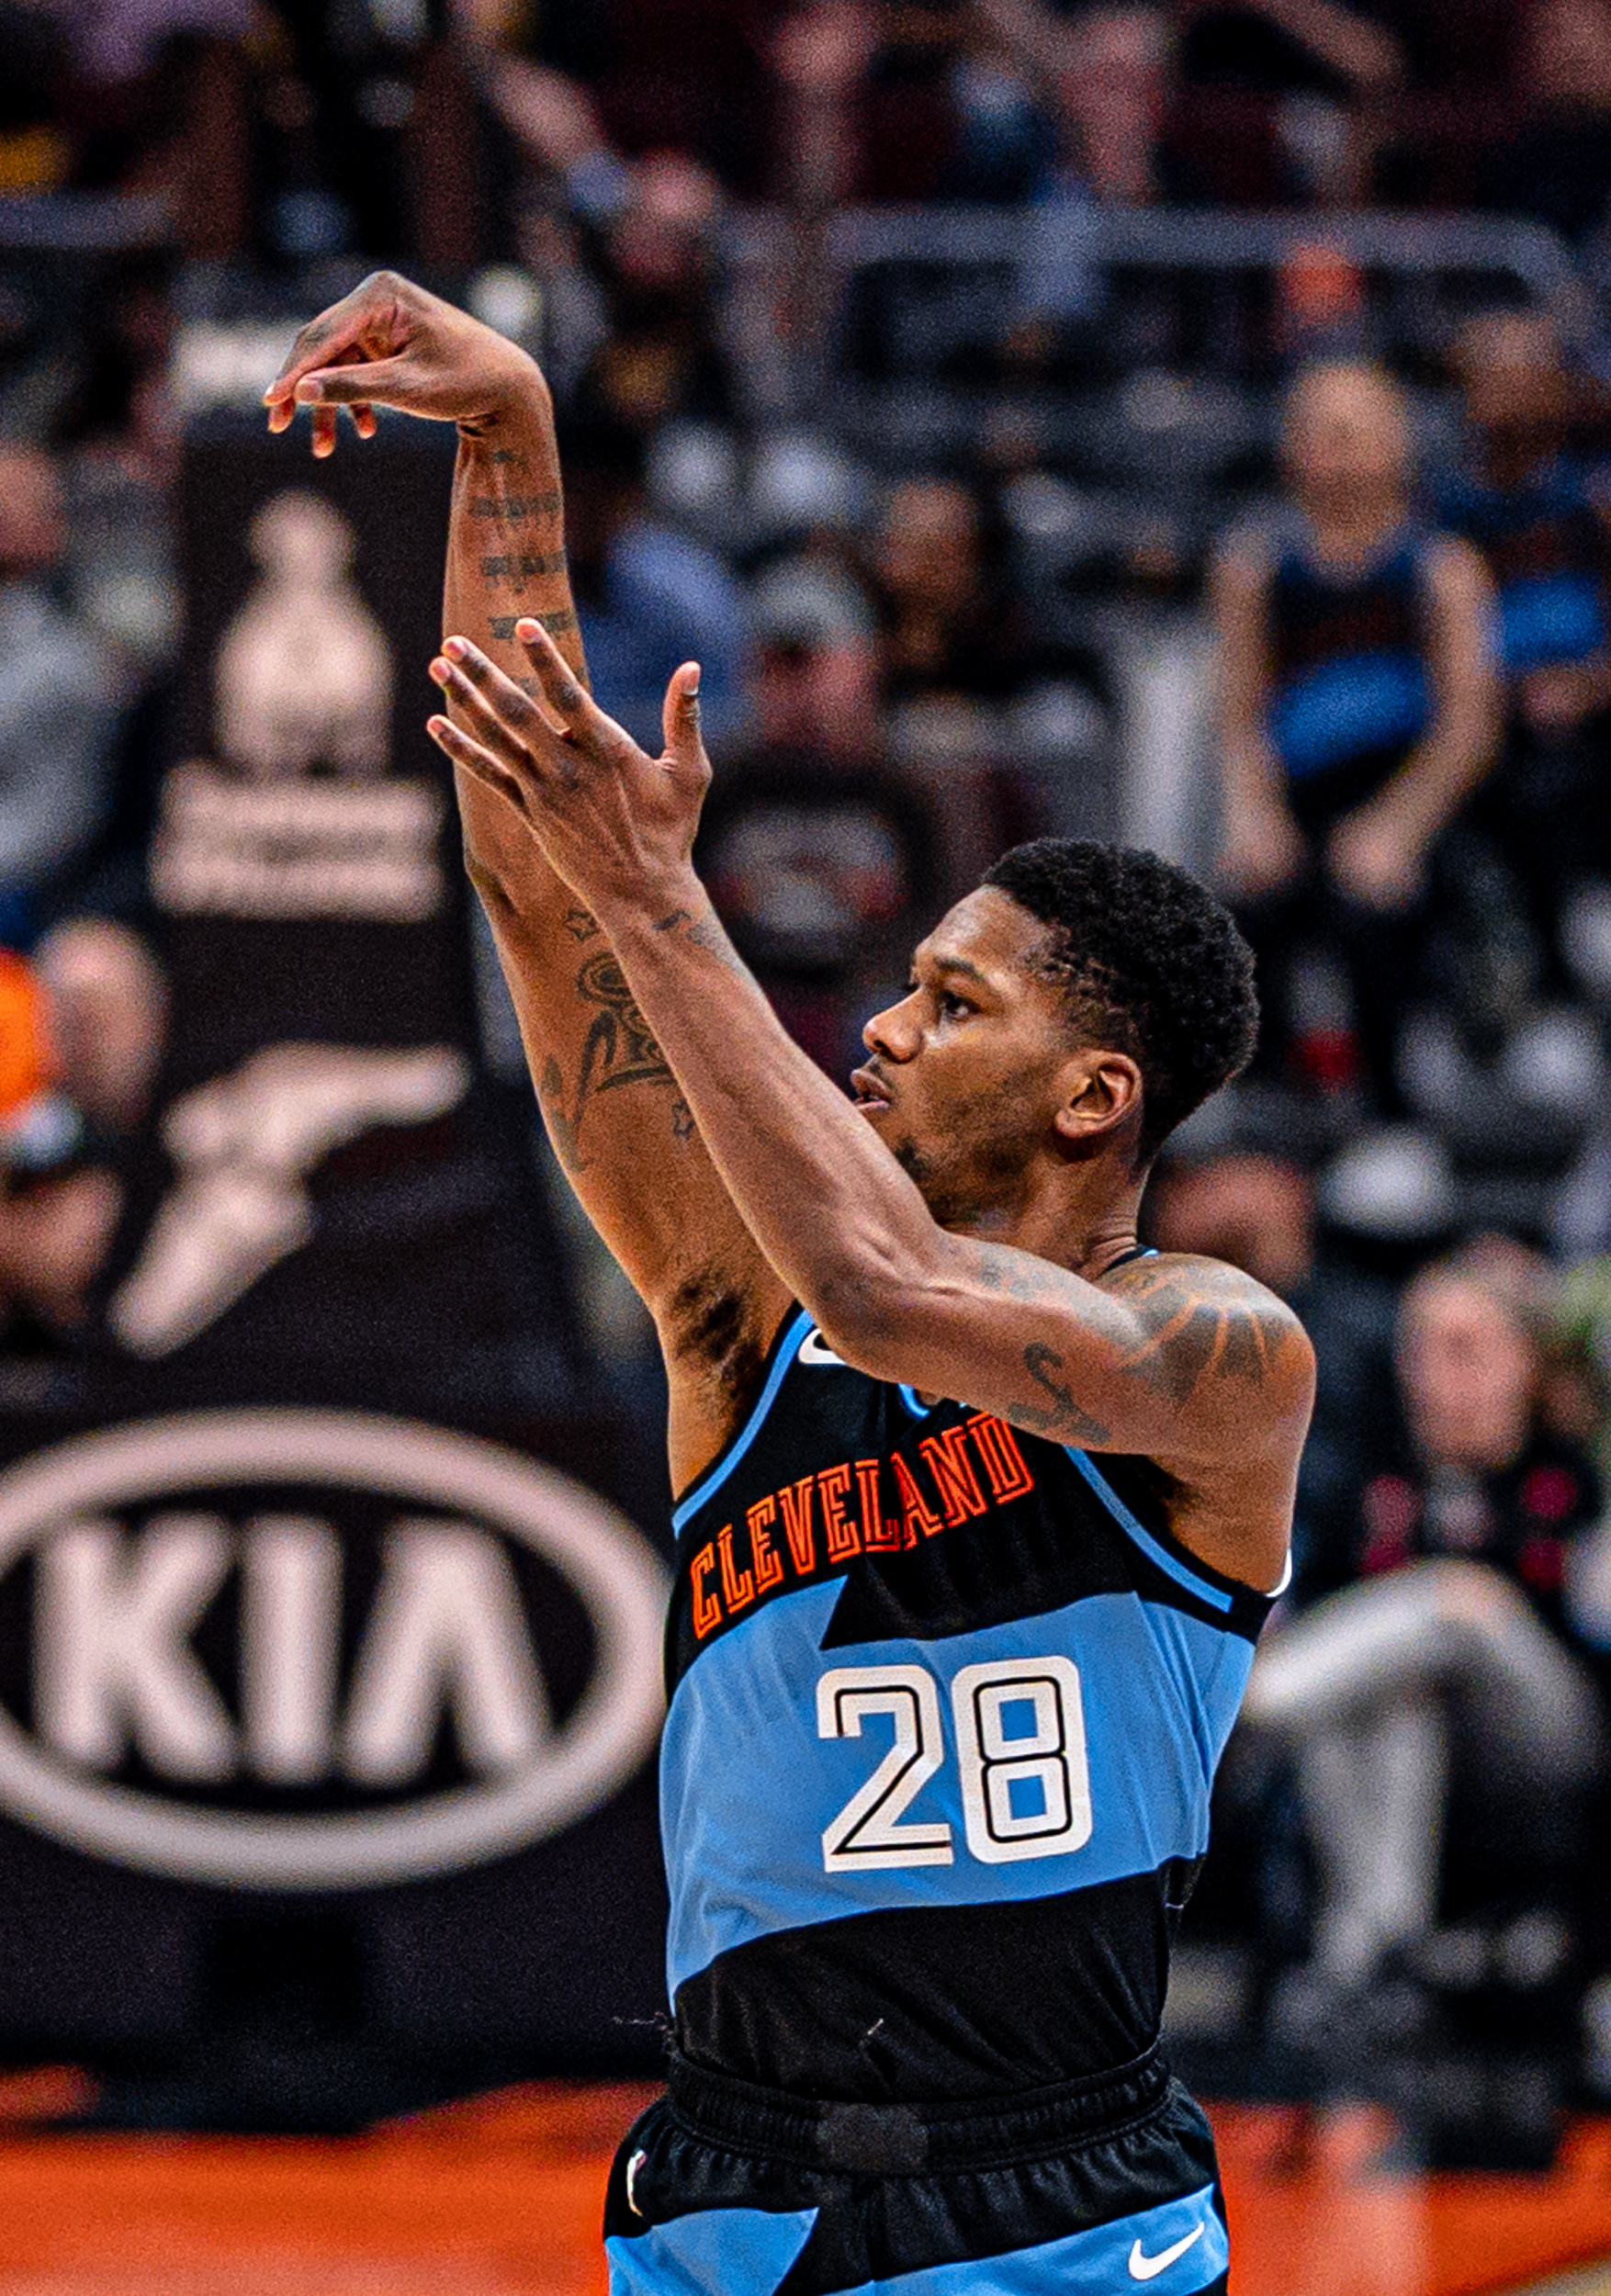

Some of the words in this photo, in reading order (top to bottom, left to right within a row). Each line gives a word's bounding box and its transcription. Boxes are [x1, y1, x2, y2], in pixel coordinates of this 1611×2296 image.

[690, 1410, 1034, 1640] CLEVELAND
[33, 1511, 553, 1784] KIA
[816, 1655, 1093, 1873] 28
